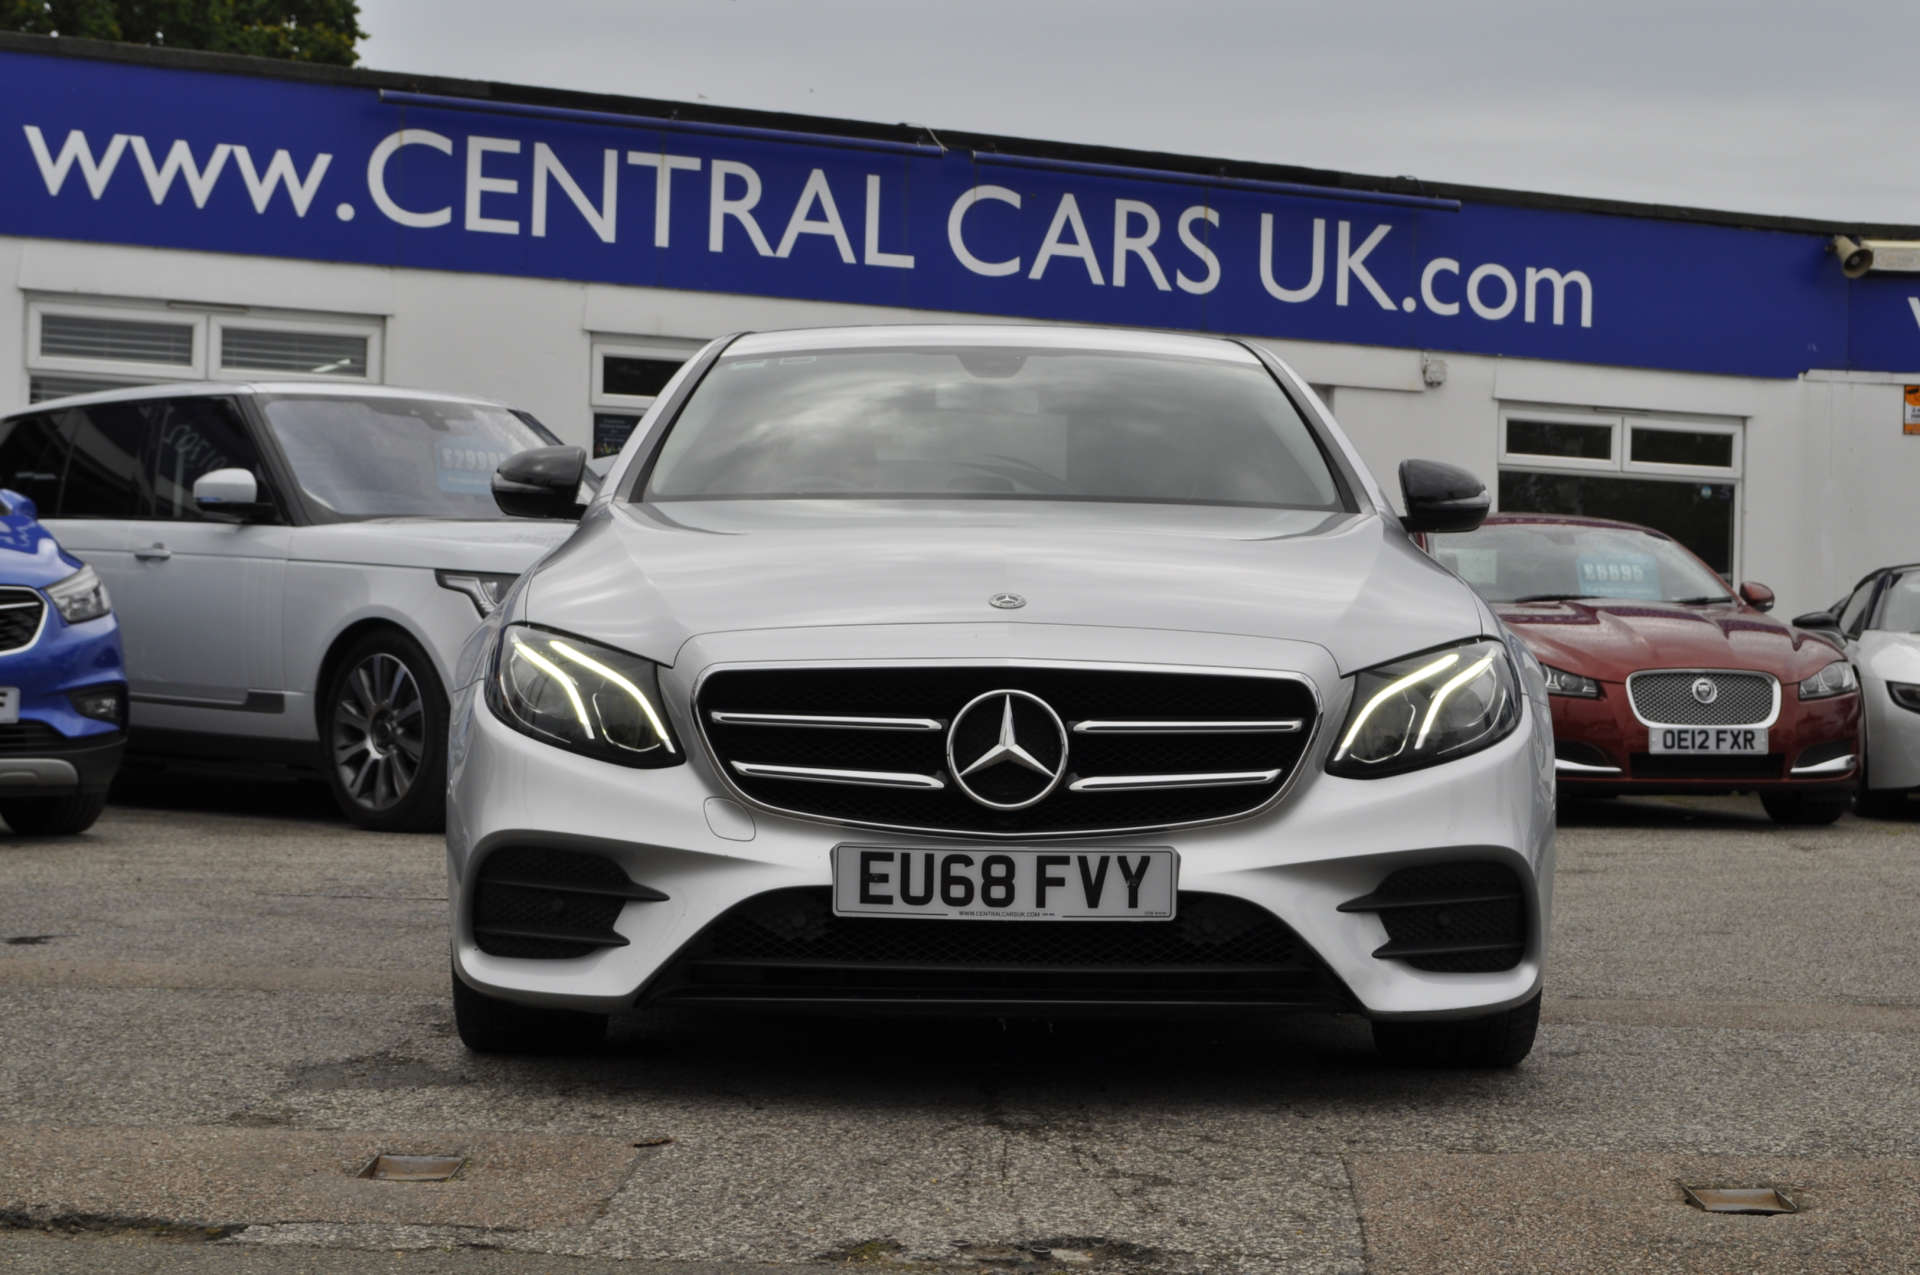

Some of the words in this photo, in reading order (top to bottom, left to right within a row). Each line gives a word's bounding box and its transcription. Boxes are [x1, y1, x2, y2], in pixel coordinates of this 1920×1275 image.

[23, 124, 915, 269] www.CENTRAL
[947, 185, 1222, 295] CARS
[1259, 212, 1593, 328] UK.com
[1662, 729, 1710, 750] OE12
[1715, 729, 1756, 750] FXR
[859, 851, 1016, 908] EU68
[1035, 855, 1151, 909] FVY
